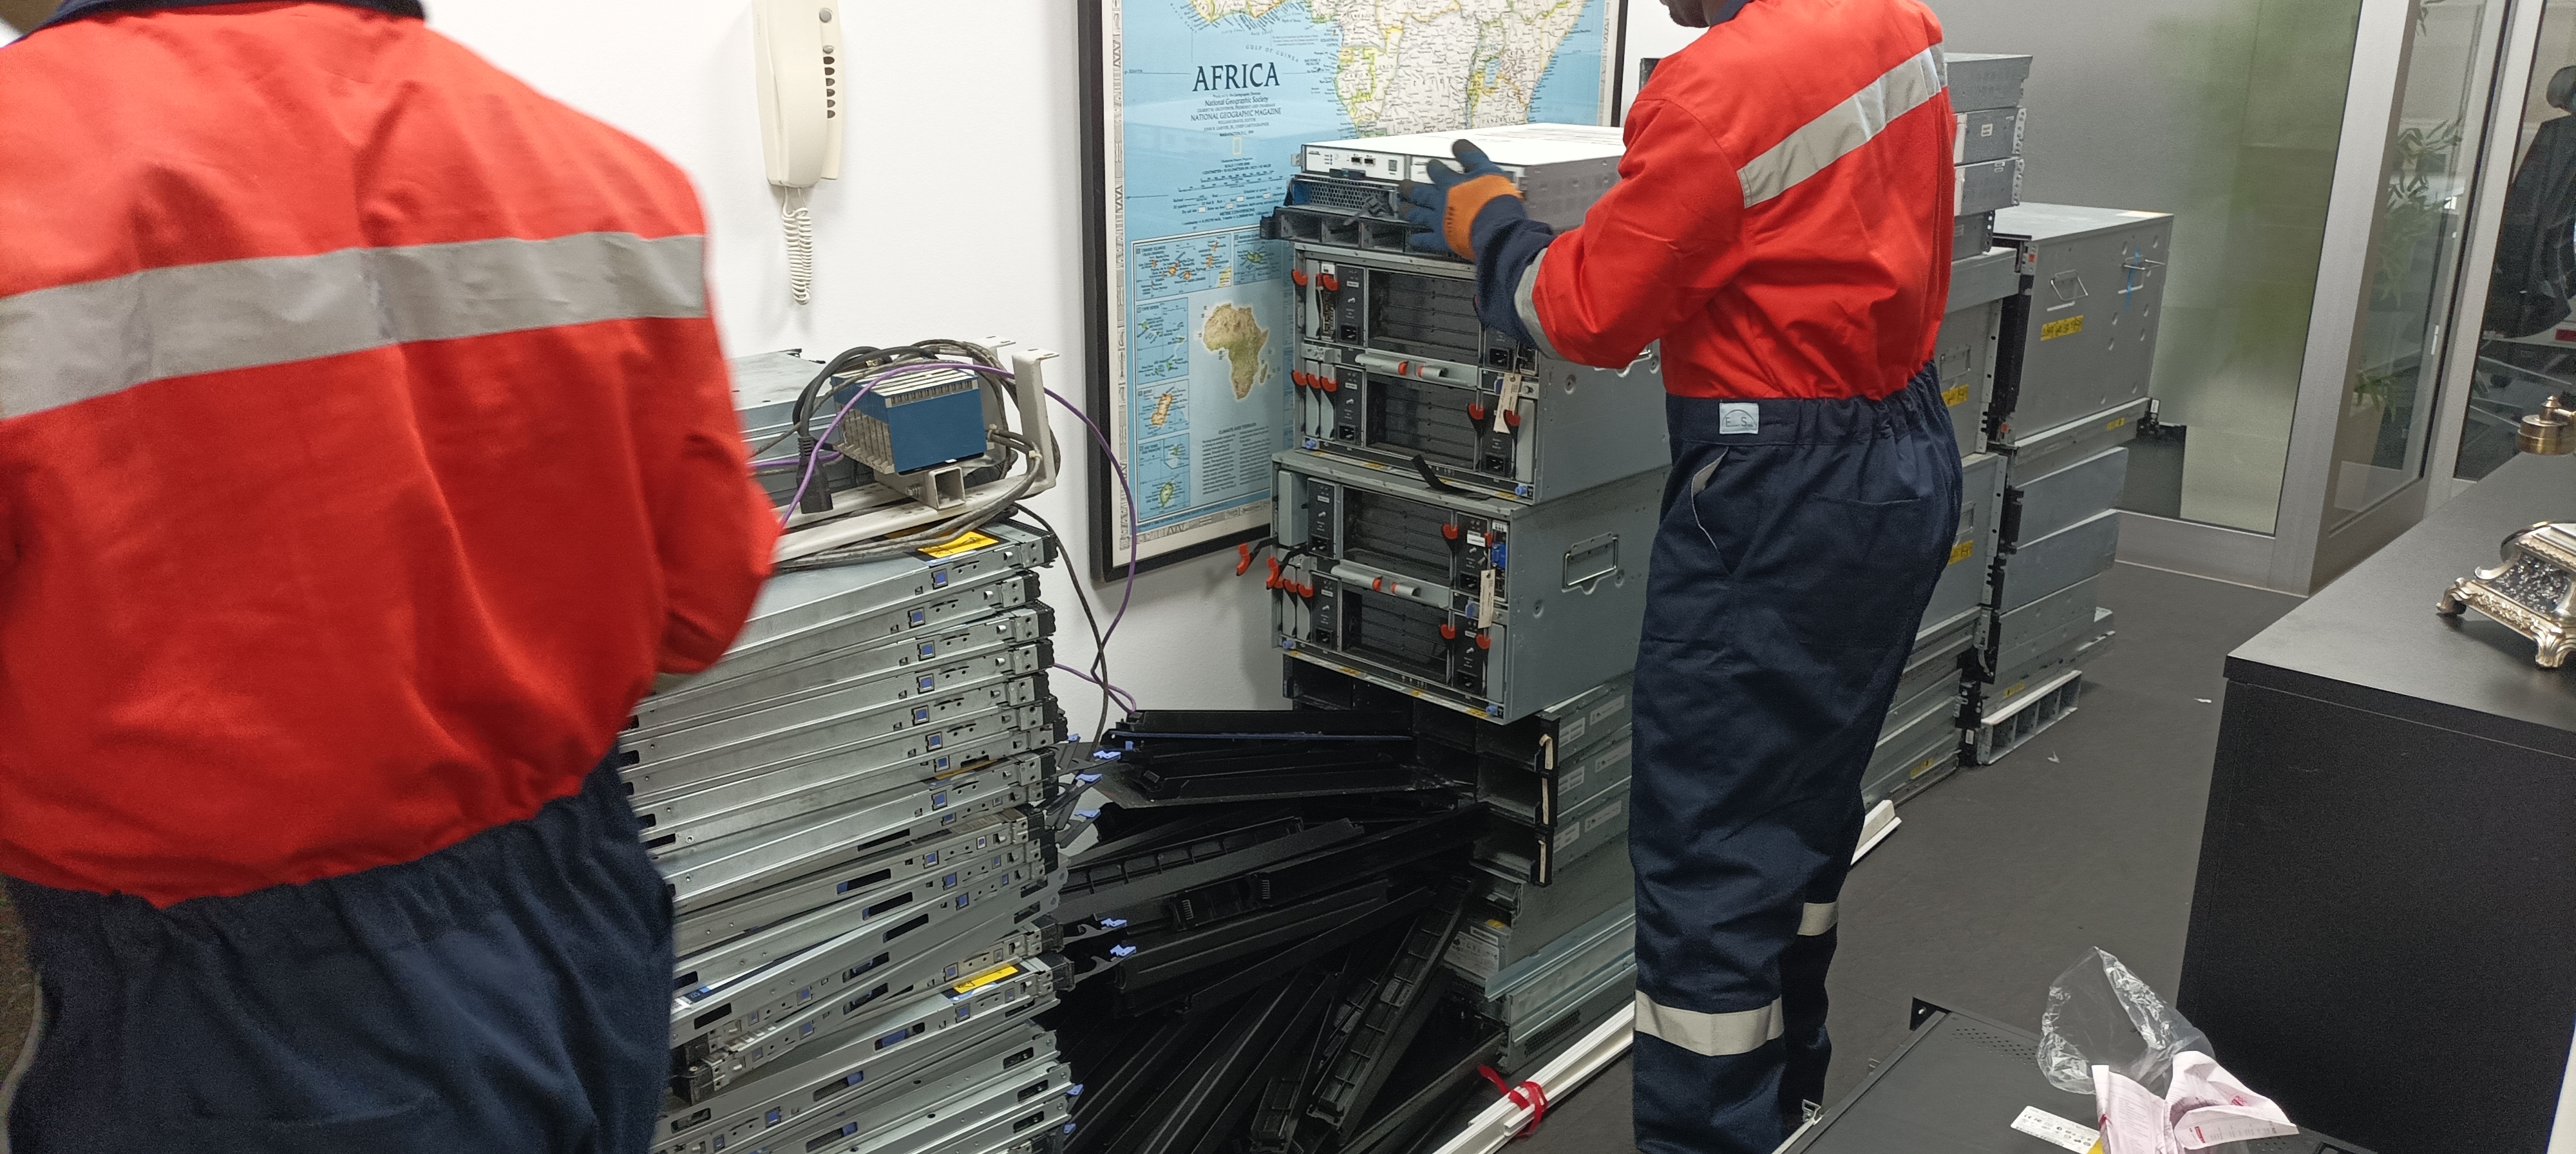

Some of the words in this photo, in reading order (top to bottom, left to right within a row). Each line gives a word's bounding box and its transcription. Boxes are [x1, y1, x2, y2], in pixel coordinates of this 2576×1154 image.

[1276, 50, 1299, 62] GUINEA
[1192, 62, 1280, 91] AFRICA
[1225, 97, 1252, 106] Geographic
[1191, 112, 1218, 121] NATIONAL
[1220, 110, 1254, 119] GEOGRAPHIC
[1255, 108, 1281, 117] MAGAZINE
